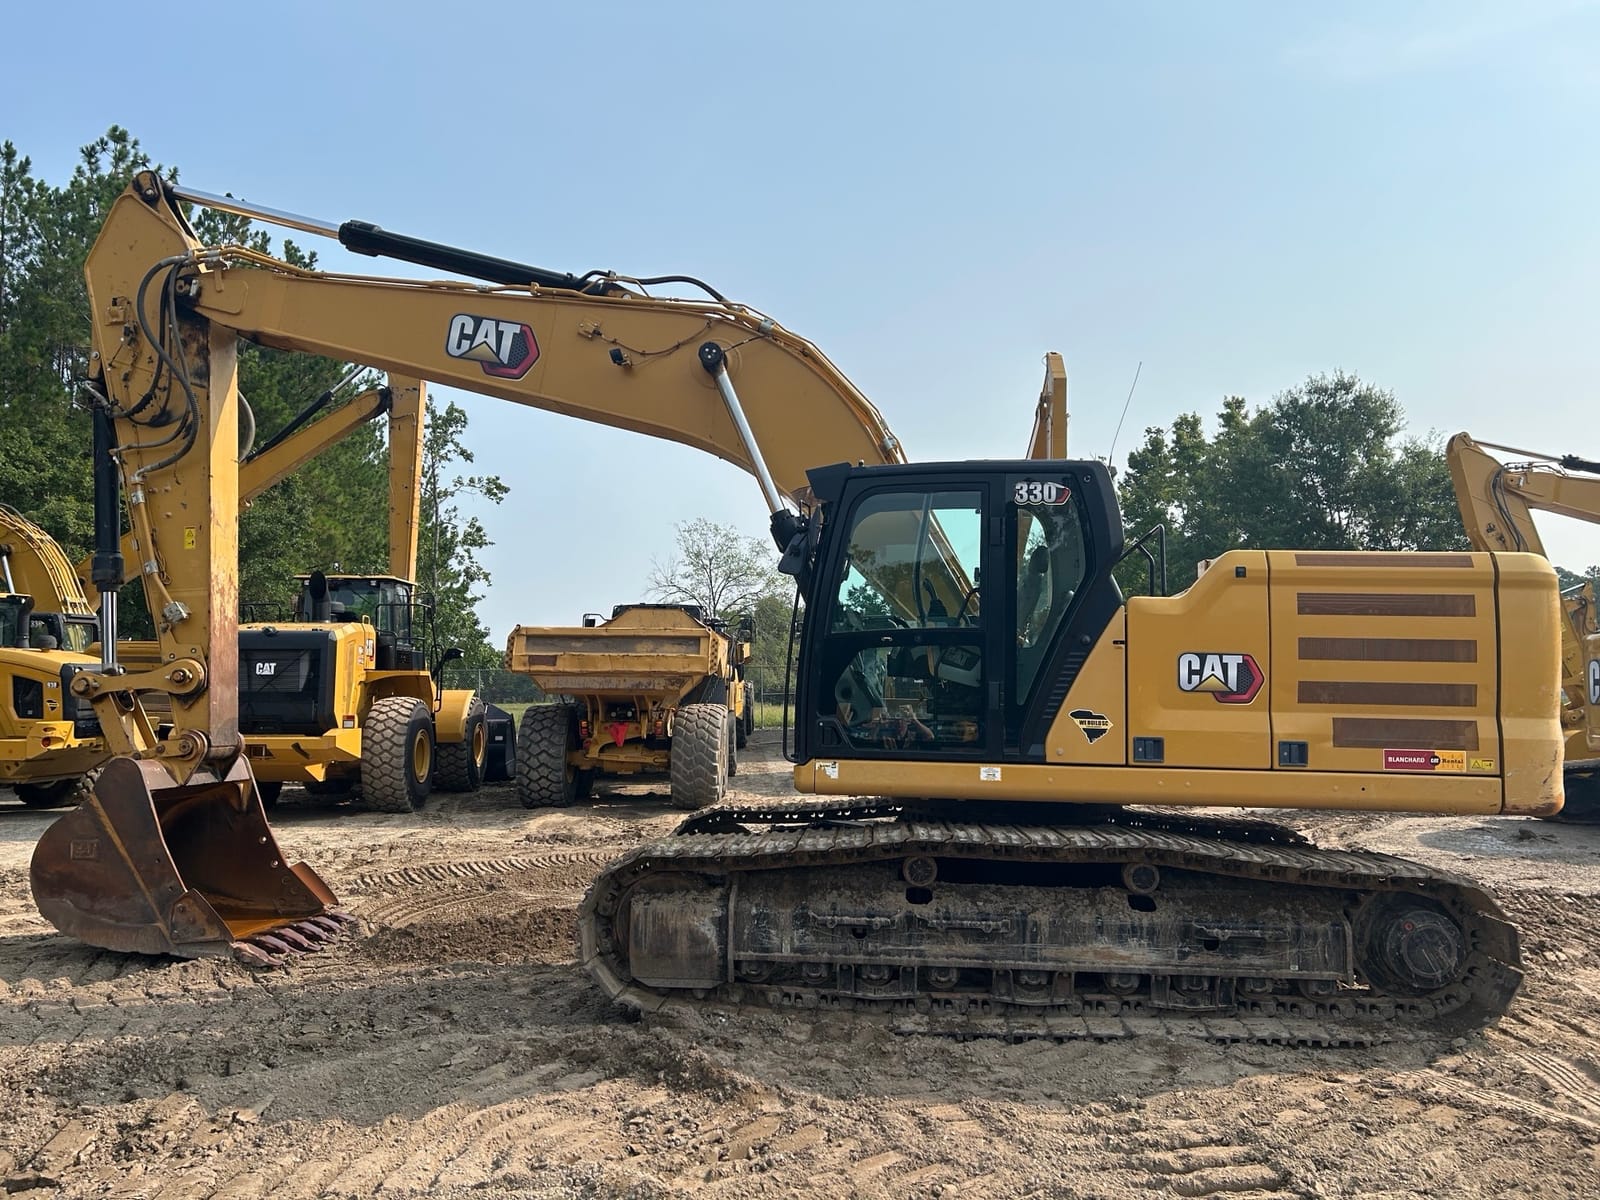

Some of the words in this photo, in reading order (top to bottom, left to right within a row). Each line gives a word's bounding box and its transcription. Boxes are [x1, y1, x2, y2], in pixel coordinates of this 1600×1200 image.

[447, 314, 521, 365] CAT
[1015, 481, 1057, 503] 330
[255, 662, 277, 675] CAT
[1179, 653, 1243, 692] CAT
[1388, 756, 1425, 764] BLANCHARD
